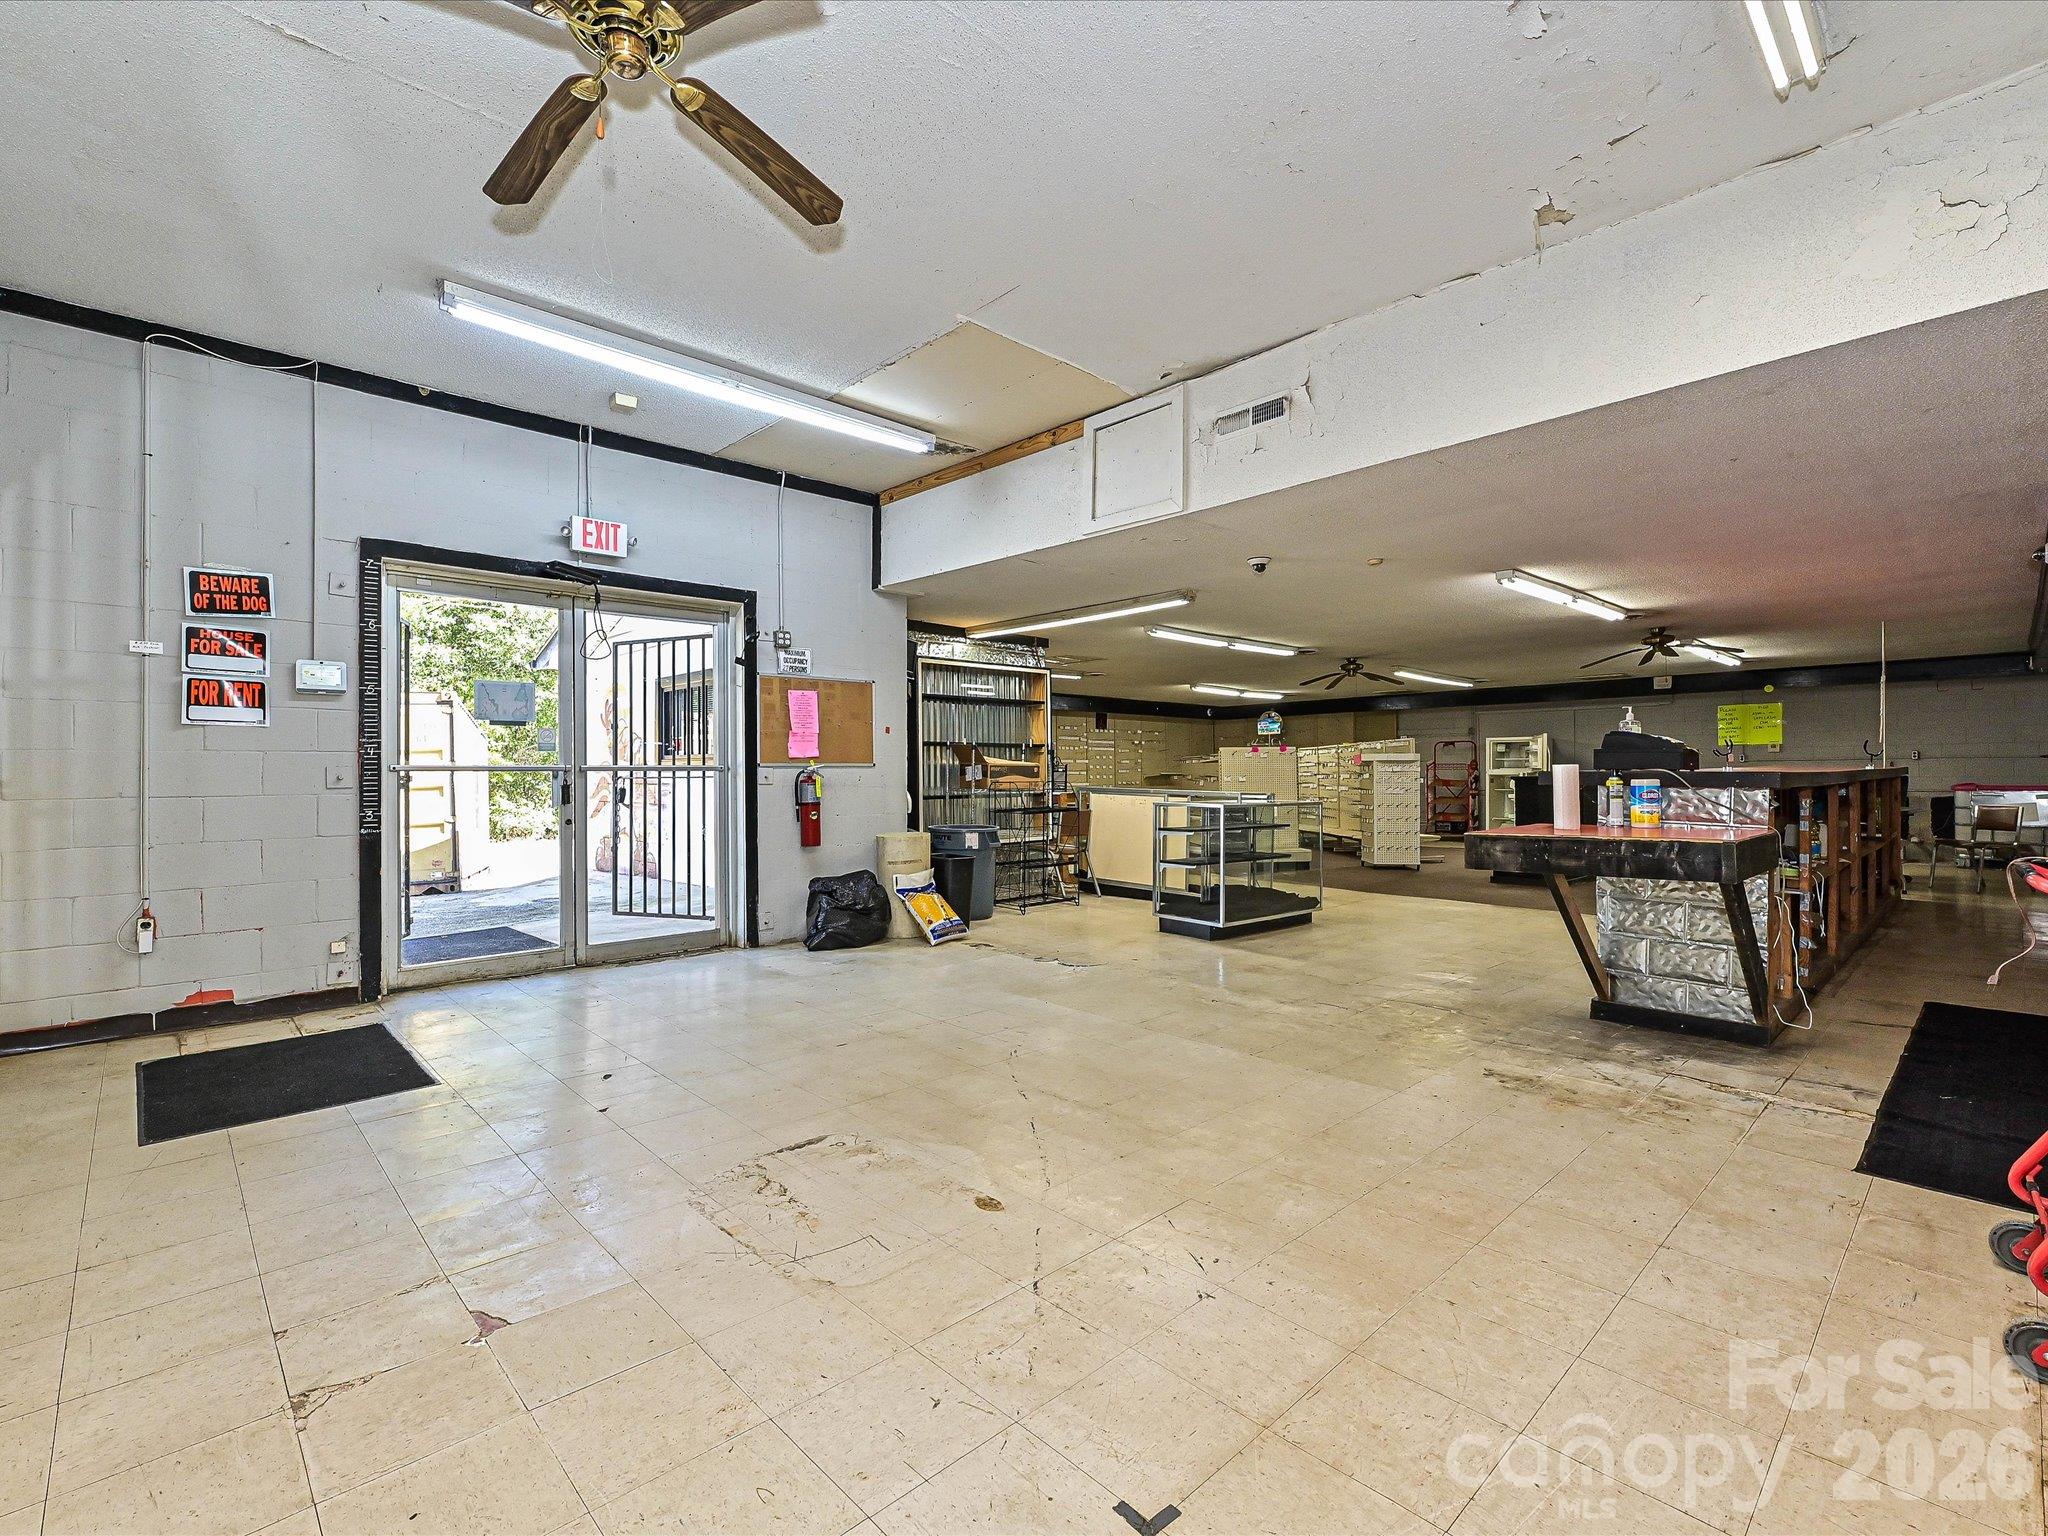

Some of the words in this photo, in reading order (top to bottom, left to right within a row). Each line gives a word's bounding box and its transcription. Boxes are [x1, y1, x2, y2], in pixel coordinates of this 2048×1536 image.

[582, 518, 621, 552] EXIT
[366, 558, 374, 566] 7
[199, 574, 260, 594] BEWARE
[193, 592, 210, 609] OF
[213, 593, 238, 610] THE
[242, 595, 267, 611] DOG
[368, 619, 376, 630] 6
[199, 628, 254, 642] HOUSE
[190, 638, 221, 655] FOR
[225, 640, 263, 658] SALE
[783, 657, 809, 666] OCCUPANCY
[789, 665, 808, 673] PERSONS
[190, 679, 219, 706] FOR
[223, 681, 262, 708] RENT
[366, 684, 375, 695] 5
[366, 747, 374, 756] 4
[365, 810, 374, 821] 3
